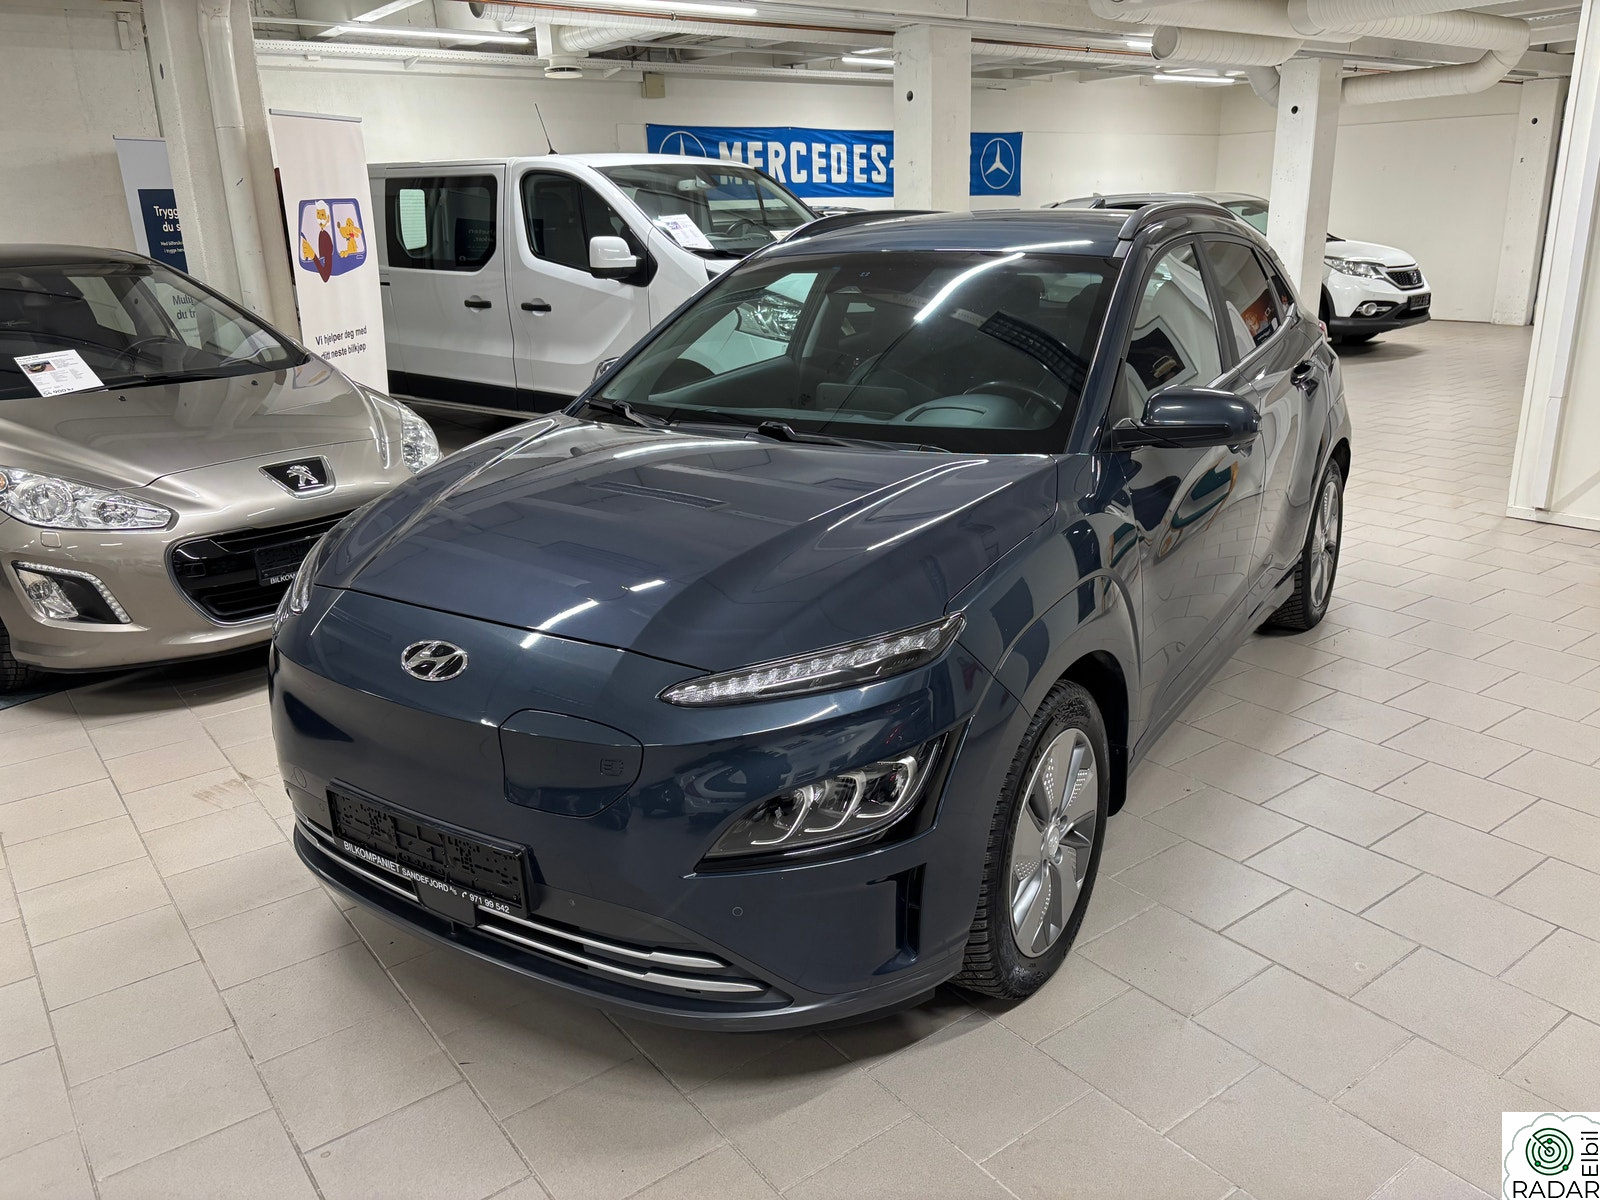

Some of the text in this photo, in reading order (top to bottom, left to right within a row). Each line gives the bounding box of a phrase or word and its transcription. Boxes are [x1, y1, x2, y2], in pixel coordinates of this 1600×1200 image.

[162, 221, 174, 232] du
[177, 310, 188, 320] du
[315, 325, 367, 345] Vi hjelper deg med
[331, 347, 347, 359] neste
[343, 840, 400, 873] BILKOMPANIET
[401, 868, 449, 892] SANDEFJORD
[469, 893, 482, 904] 971
[484, 898, 494, 908] 99
[495, 902, 510, 914] 542
